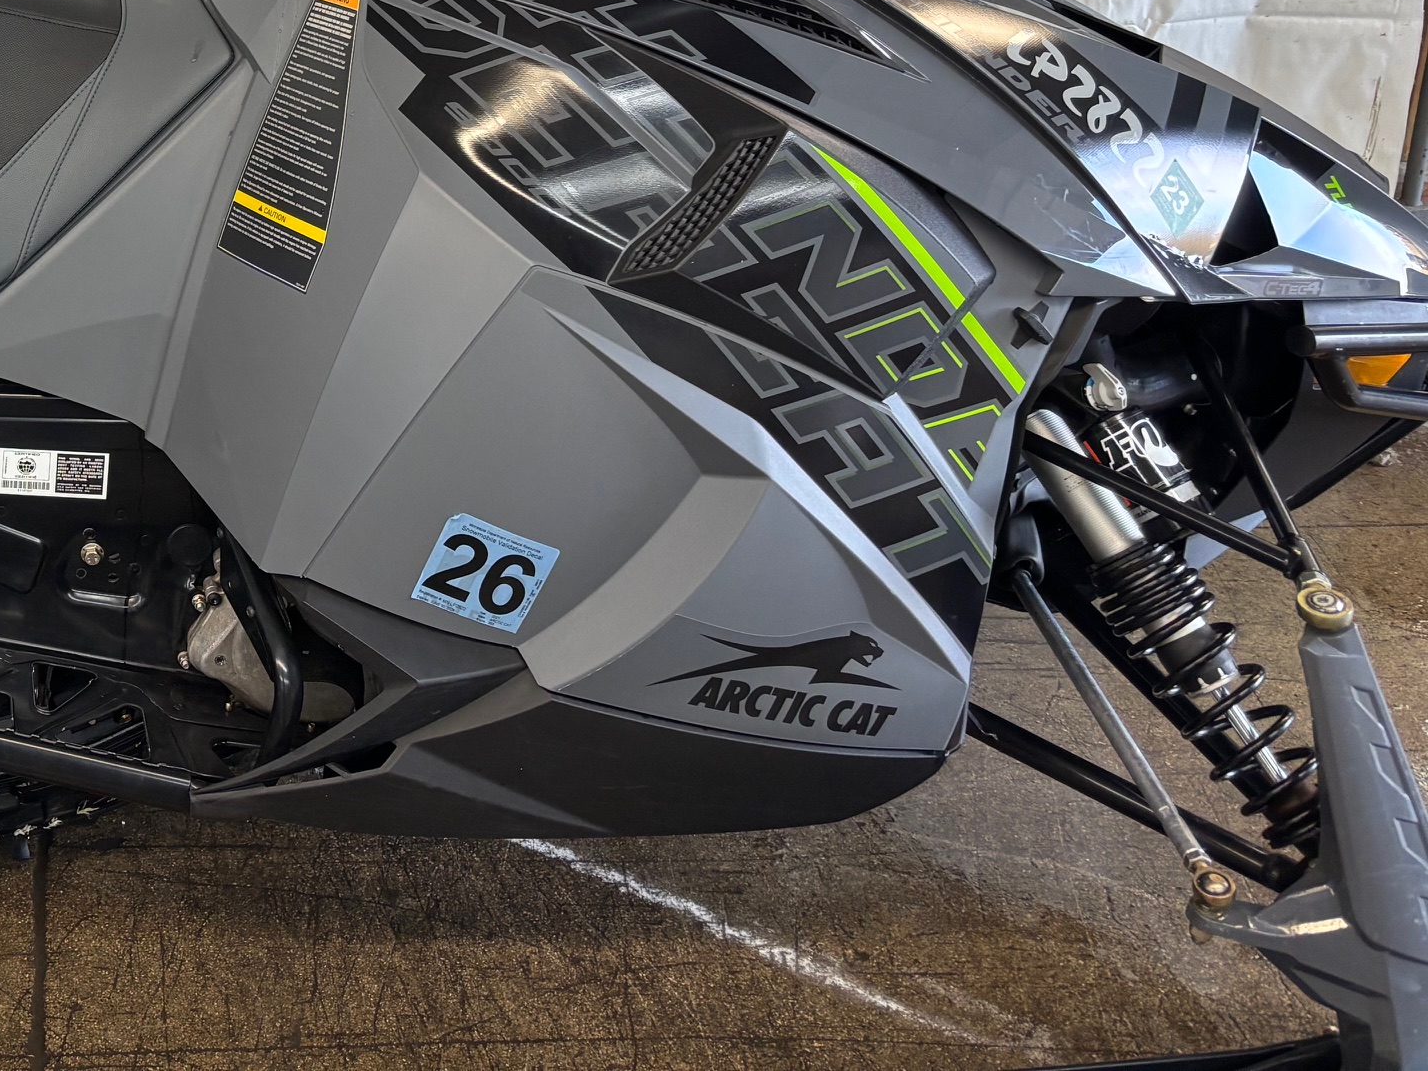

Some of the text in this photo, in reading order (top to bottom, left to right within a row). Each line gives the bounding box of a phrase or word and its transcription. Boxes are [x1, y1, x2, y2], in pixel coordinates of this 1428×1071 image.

[263, 206, 287, 223] CAUTION
[1162, 175, 1189, 216] 23
[461, 525, 544, 561] Snowmobile Validation Decal
[422, 533, 536, 615] 26
[687, 677, 898, 737] ARCTIC CAT
